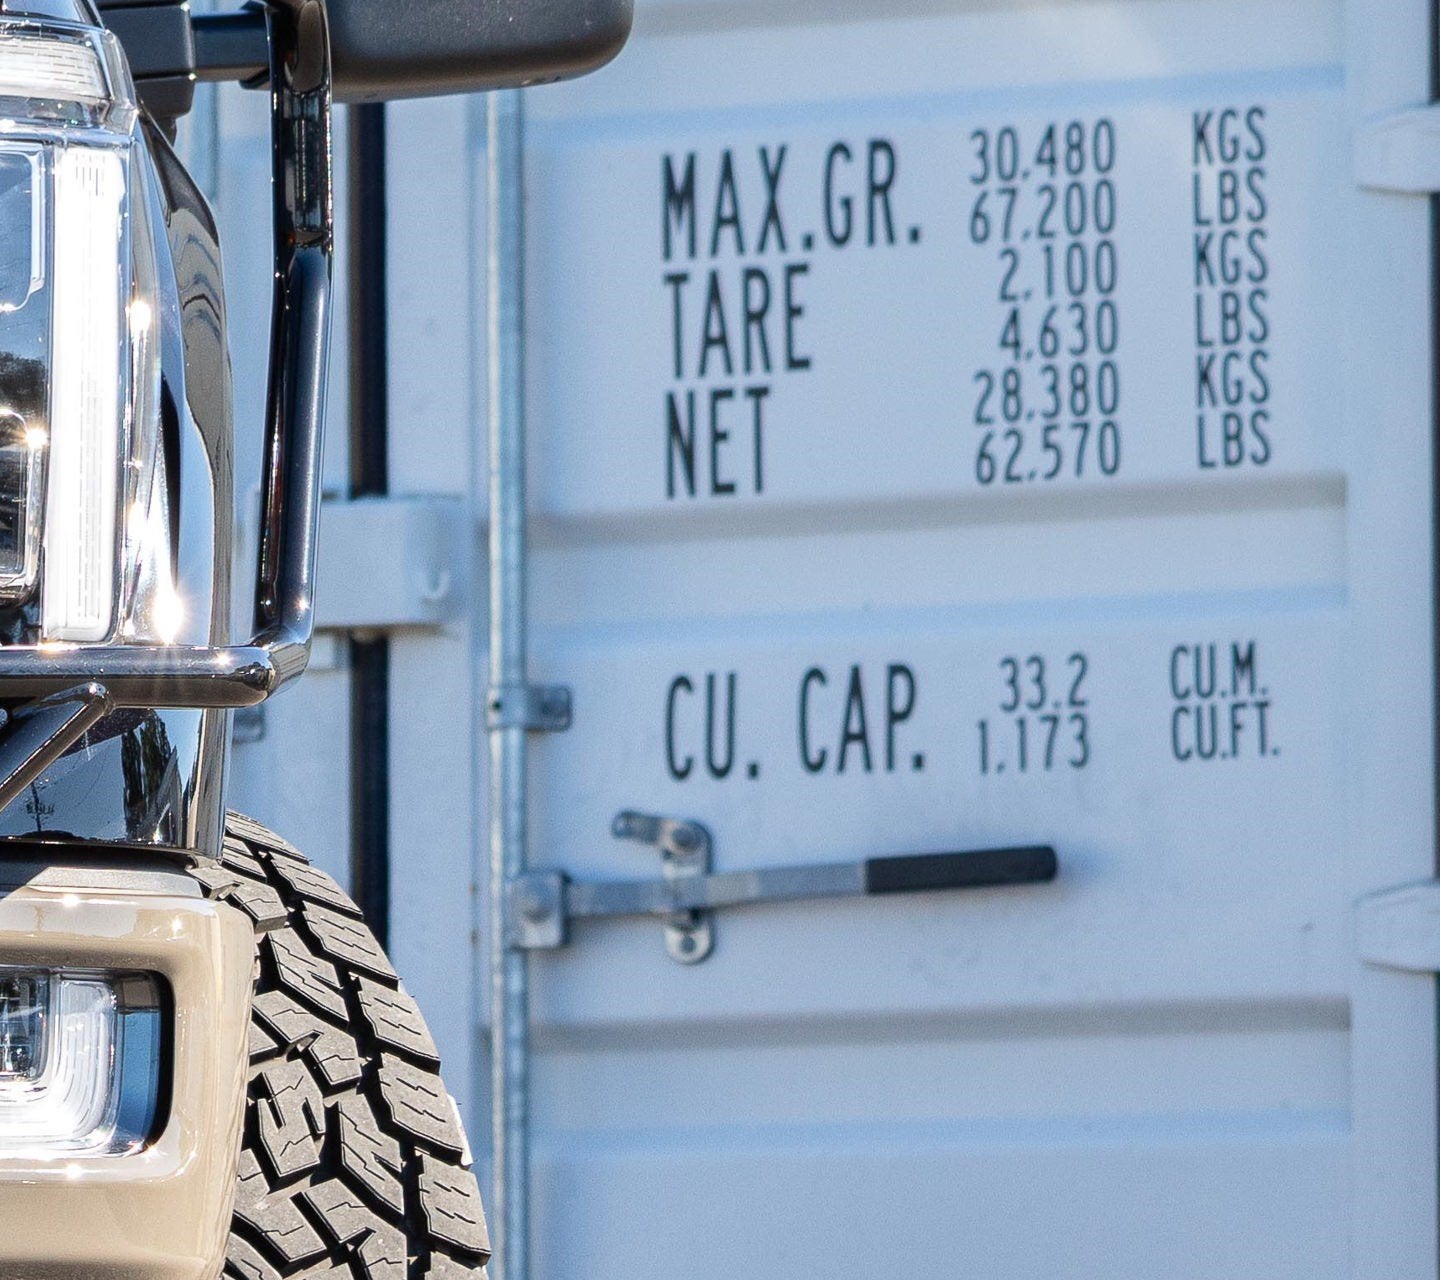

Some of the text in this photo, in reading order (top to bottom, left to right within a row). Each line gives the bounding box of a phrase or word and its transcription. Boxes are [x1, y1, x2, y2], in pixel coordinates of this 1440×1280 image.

[1193, 107, 1266, 166] KGS
[1194, 167, 1267, 226] LBS
[664, 263, 812, 379] TARE
[1194, 228, 1268, 287] KGS
[1196, 288, 1269, 347] LBS
[666, 386, 771, 499] NET
[1197, 349, 1270, 407] KGS
[1198, 410, 1271, 468] LBS
[665, 672, 760, 781] CU.
[799, 663, 925, 774] CAP.
[999, 653, 1088, 712] 33.2
